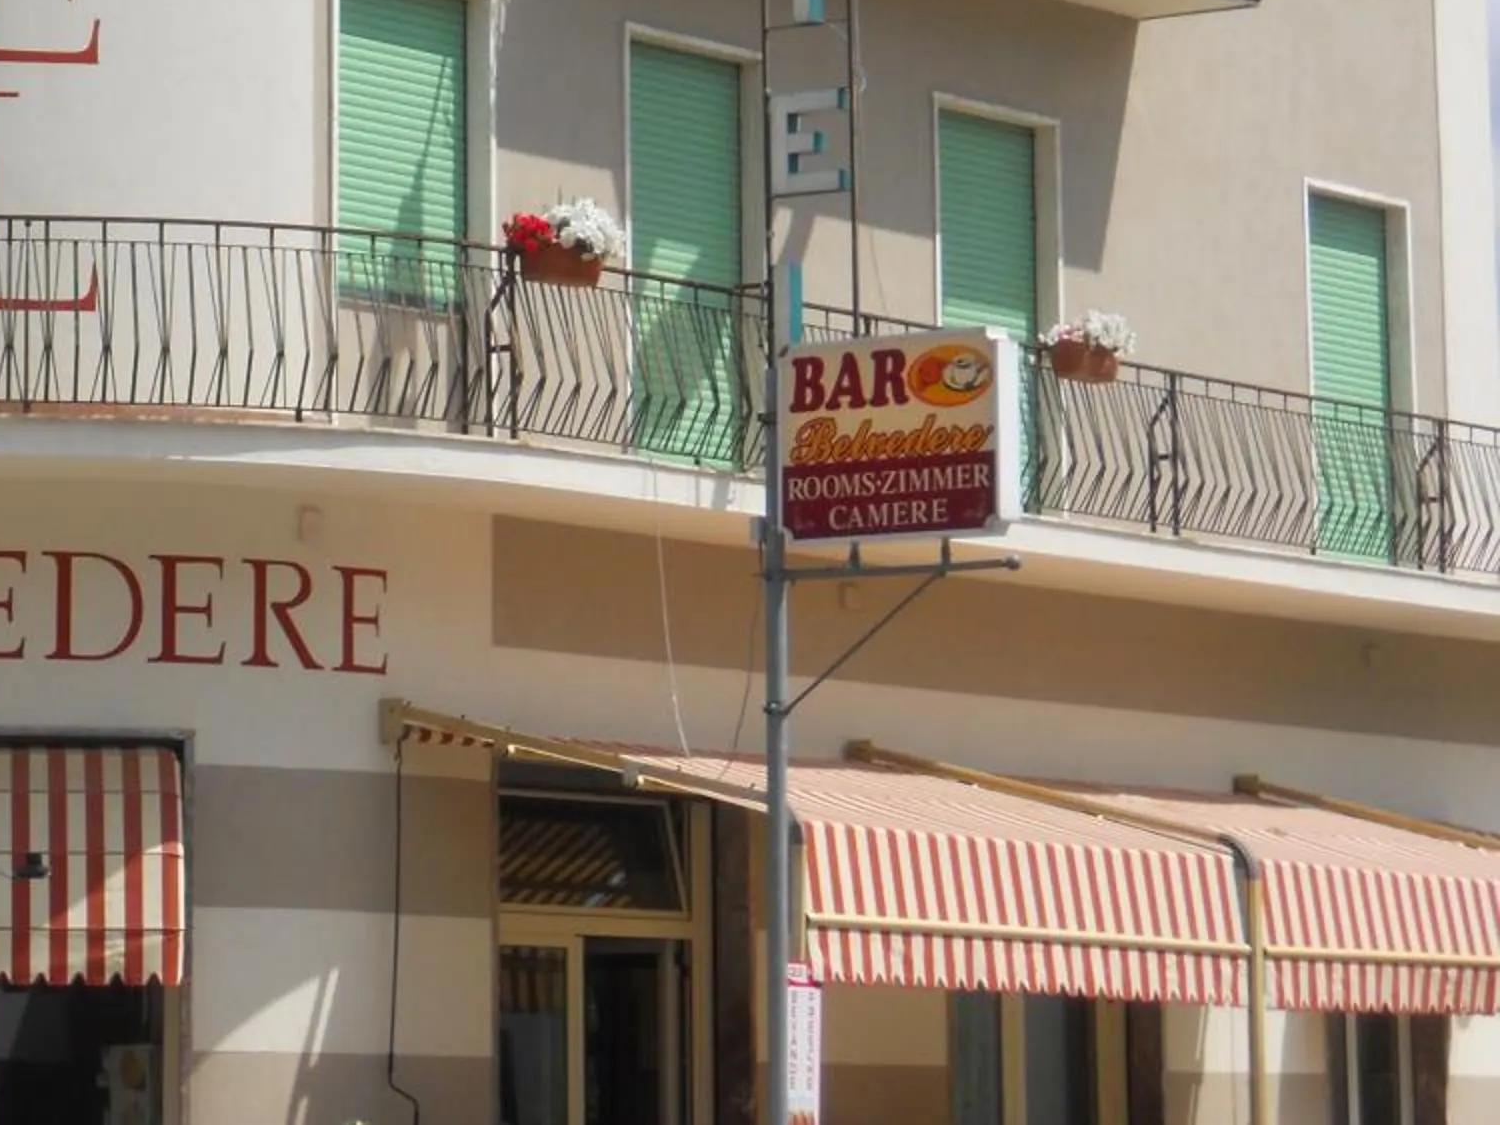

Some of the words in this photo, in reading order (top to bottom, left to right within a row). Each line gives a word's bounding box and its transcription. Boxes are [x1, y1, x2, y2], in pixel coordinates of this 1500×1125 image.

[789, 348, 909, 413] BAR
[790, 414, 994, 463] Belvedere
[828, 497, 949, 531] CAMERE
